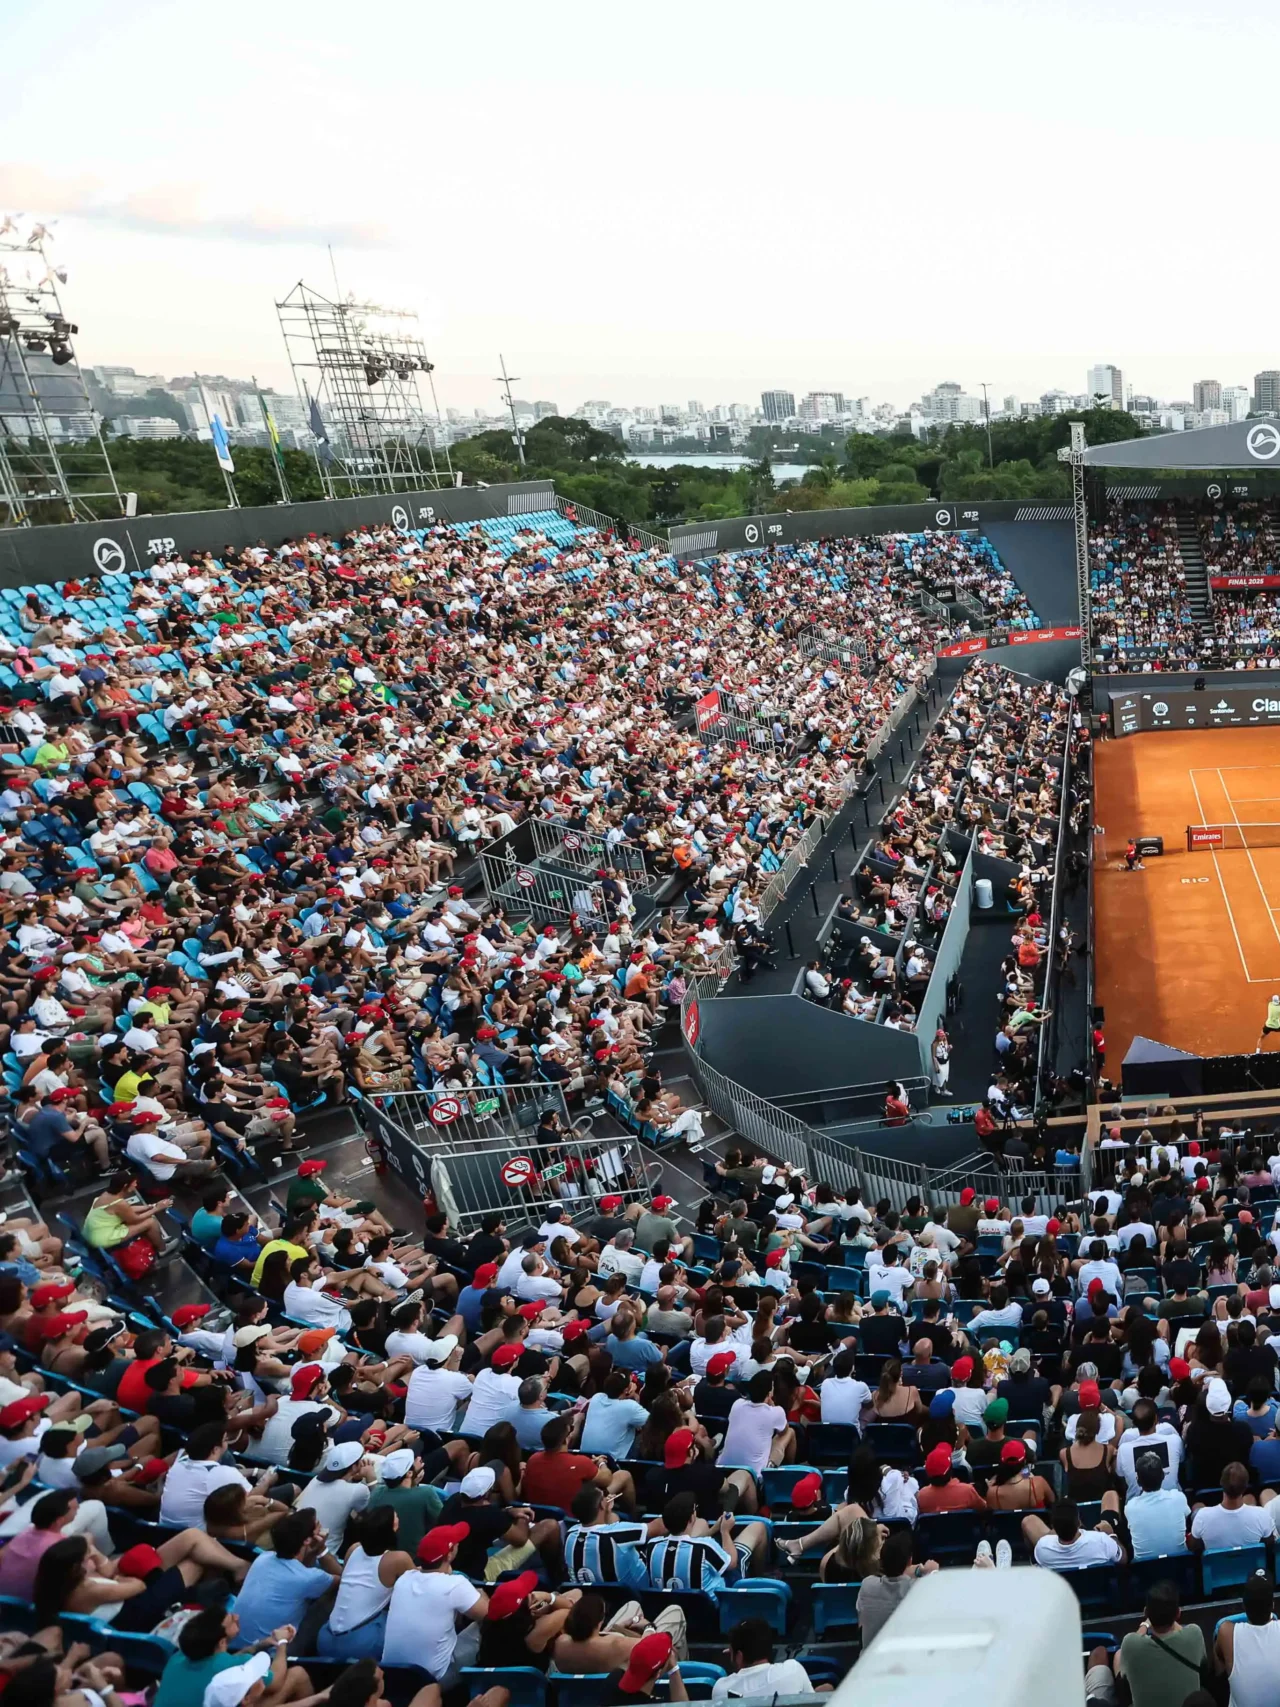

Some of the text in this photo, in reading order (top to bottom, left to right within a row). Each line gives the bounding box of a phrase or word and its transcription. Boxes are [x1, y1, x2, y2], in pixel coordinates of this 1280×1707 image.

[419, 506, 434, 519] ATP
[962, 511, 979, 519] ATP
[767, 524, 782, 533] ATP
[146, 537, 175, 555] ATP
[1038, 631, 1054, 639] Claro
[1065, 628, 1080, 636] Claro
[1013, 633, 1028, 642] Claro
[1193, 833, 1221, 841] Emirates
[601, 1262, 615, 1273] FILA
